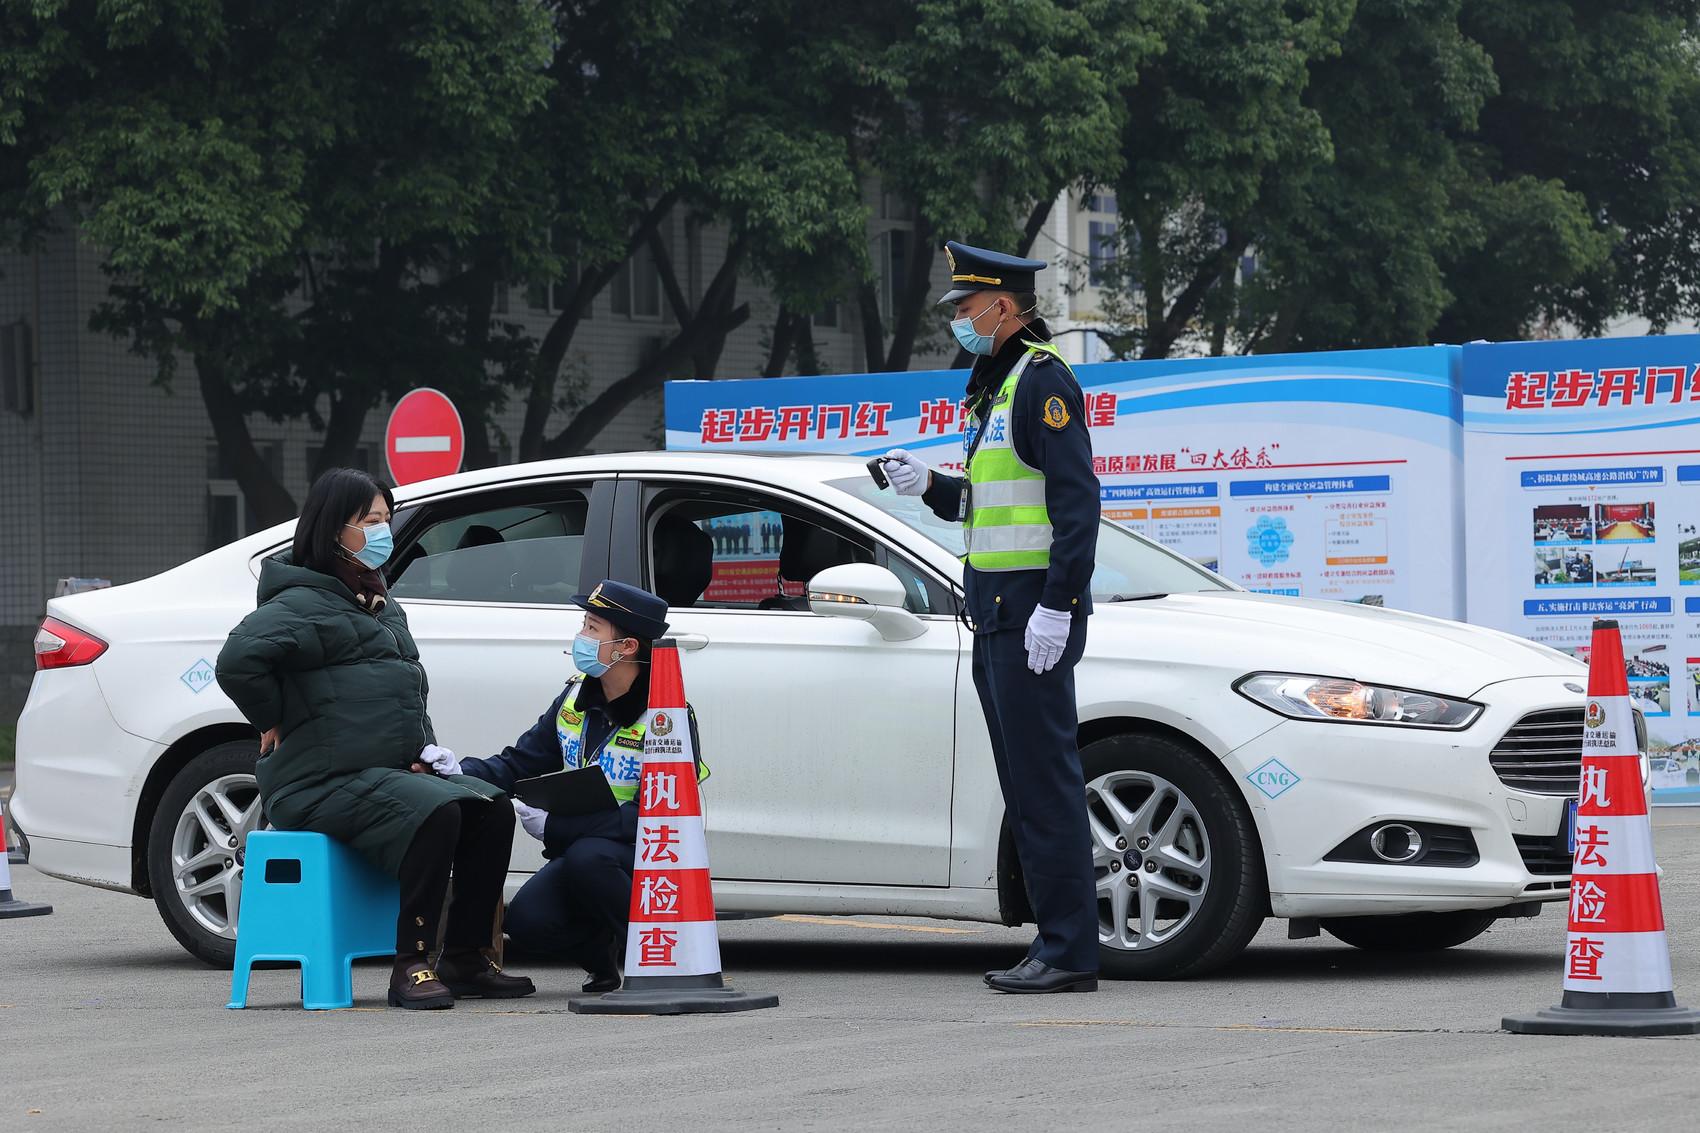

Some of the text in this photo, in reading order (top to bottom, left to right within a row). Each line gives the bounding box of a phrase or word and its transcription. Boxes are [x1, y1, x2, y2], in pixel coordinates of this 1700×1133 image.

[701, 402, 892, 444] 起步开门红
[188, 670, 211, 683] CNG
[1257, 771, 1290, 787] CNG
[638, 771, 681, 967] 执法检查
[1568, 766, 1611, 981] 执法检查
